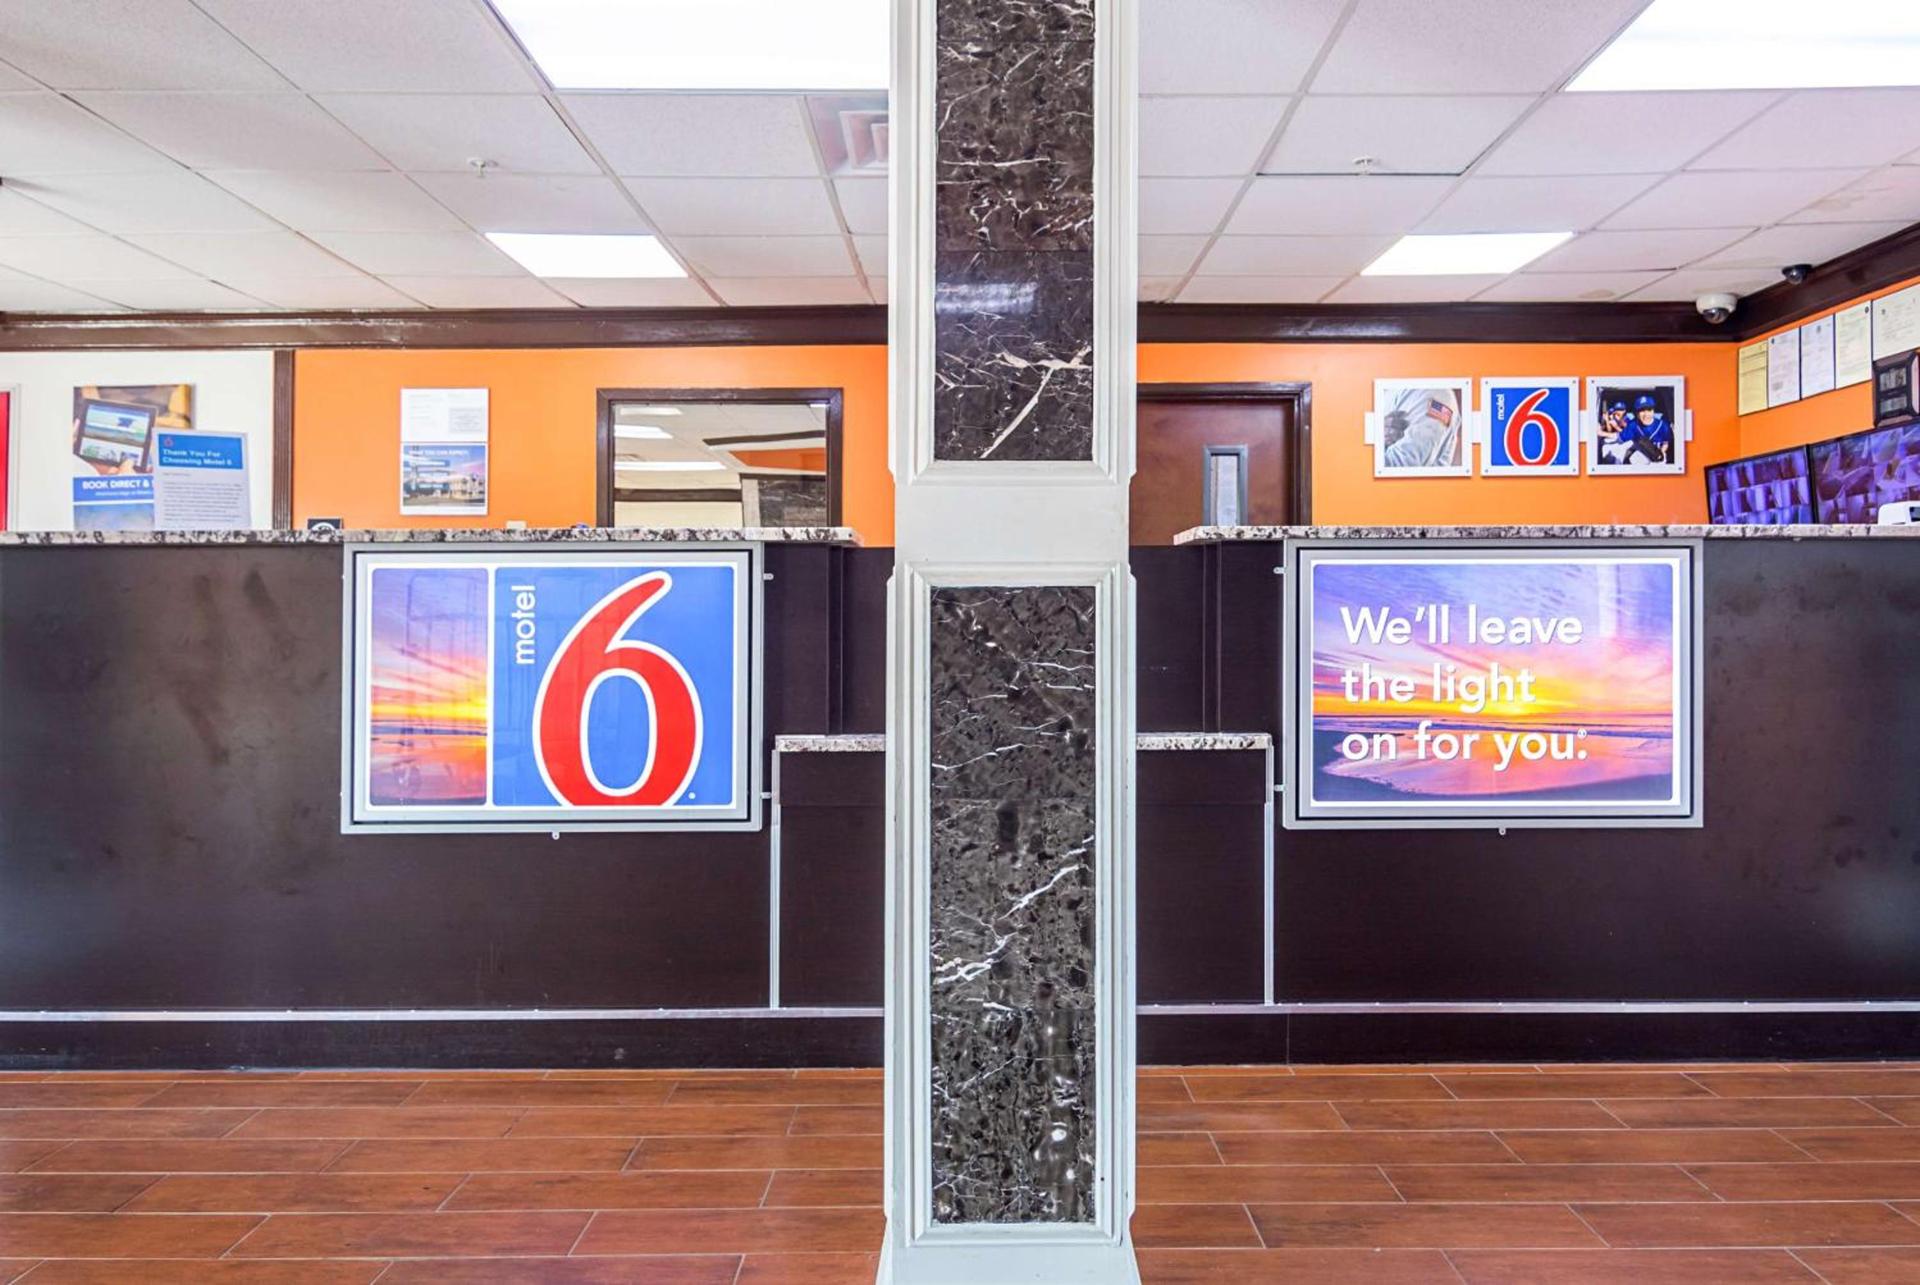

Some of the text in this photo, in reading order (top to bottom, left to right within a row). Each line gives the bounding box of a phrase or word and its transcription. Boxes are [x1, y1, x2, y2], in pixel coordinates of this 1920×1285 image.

[1496, 389, 1560, 466] motel 6
[162, 457, 201, 466] Choosing
[82, 480, 108, 490] BOOK
[110, 480, 141, 488] DIRECT
[1340, 604, 1583, 644] We'll leave
[511, 570, 703, 807] motel 6
[1340, 663, 1536, 713] the light
[1341, 733, 1396, 760] on
[1414, 721, 1479, 760] for
